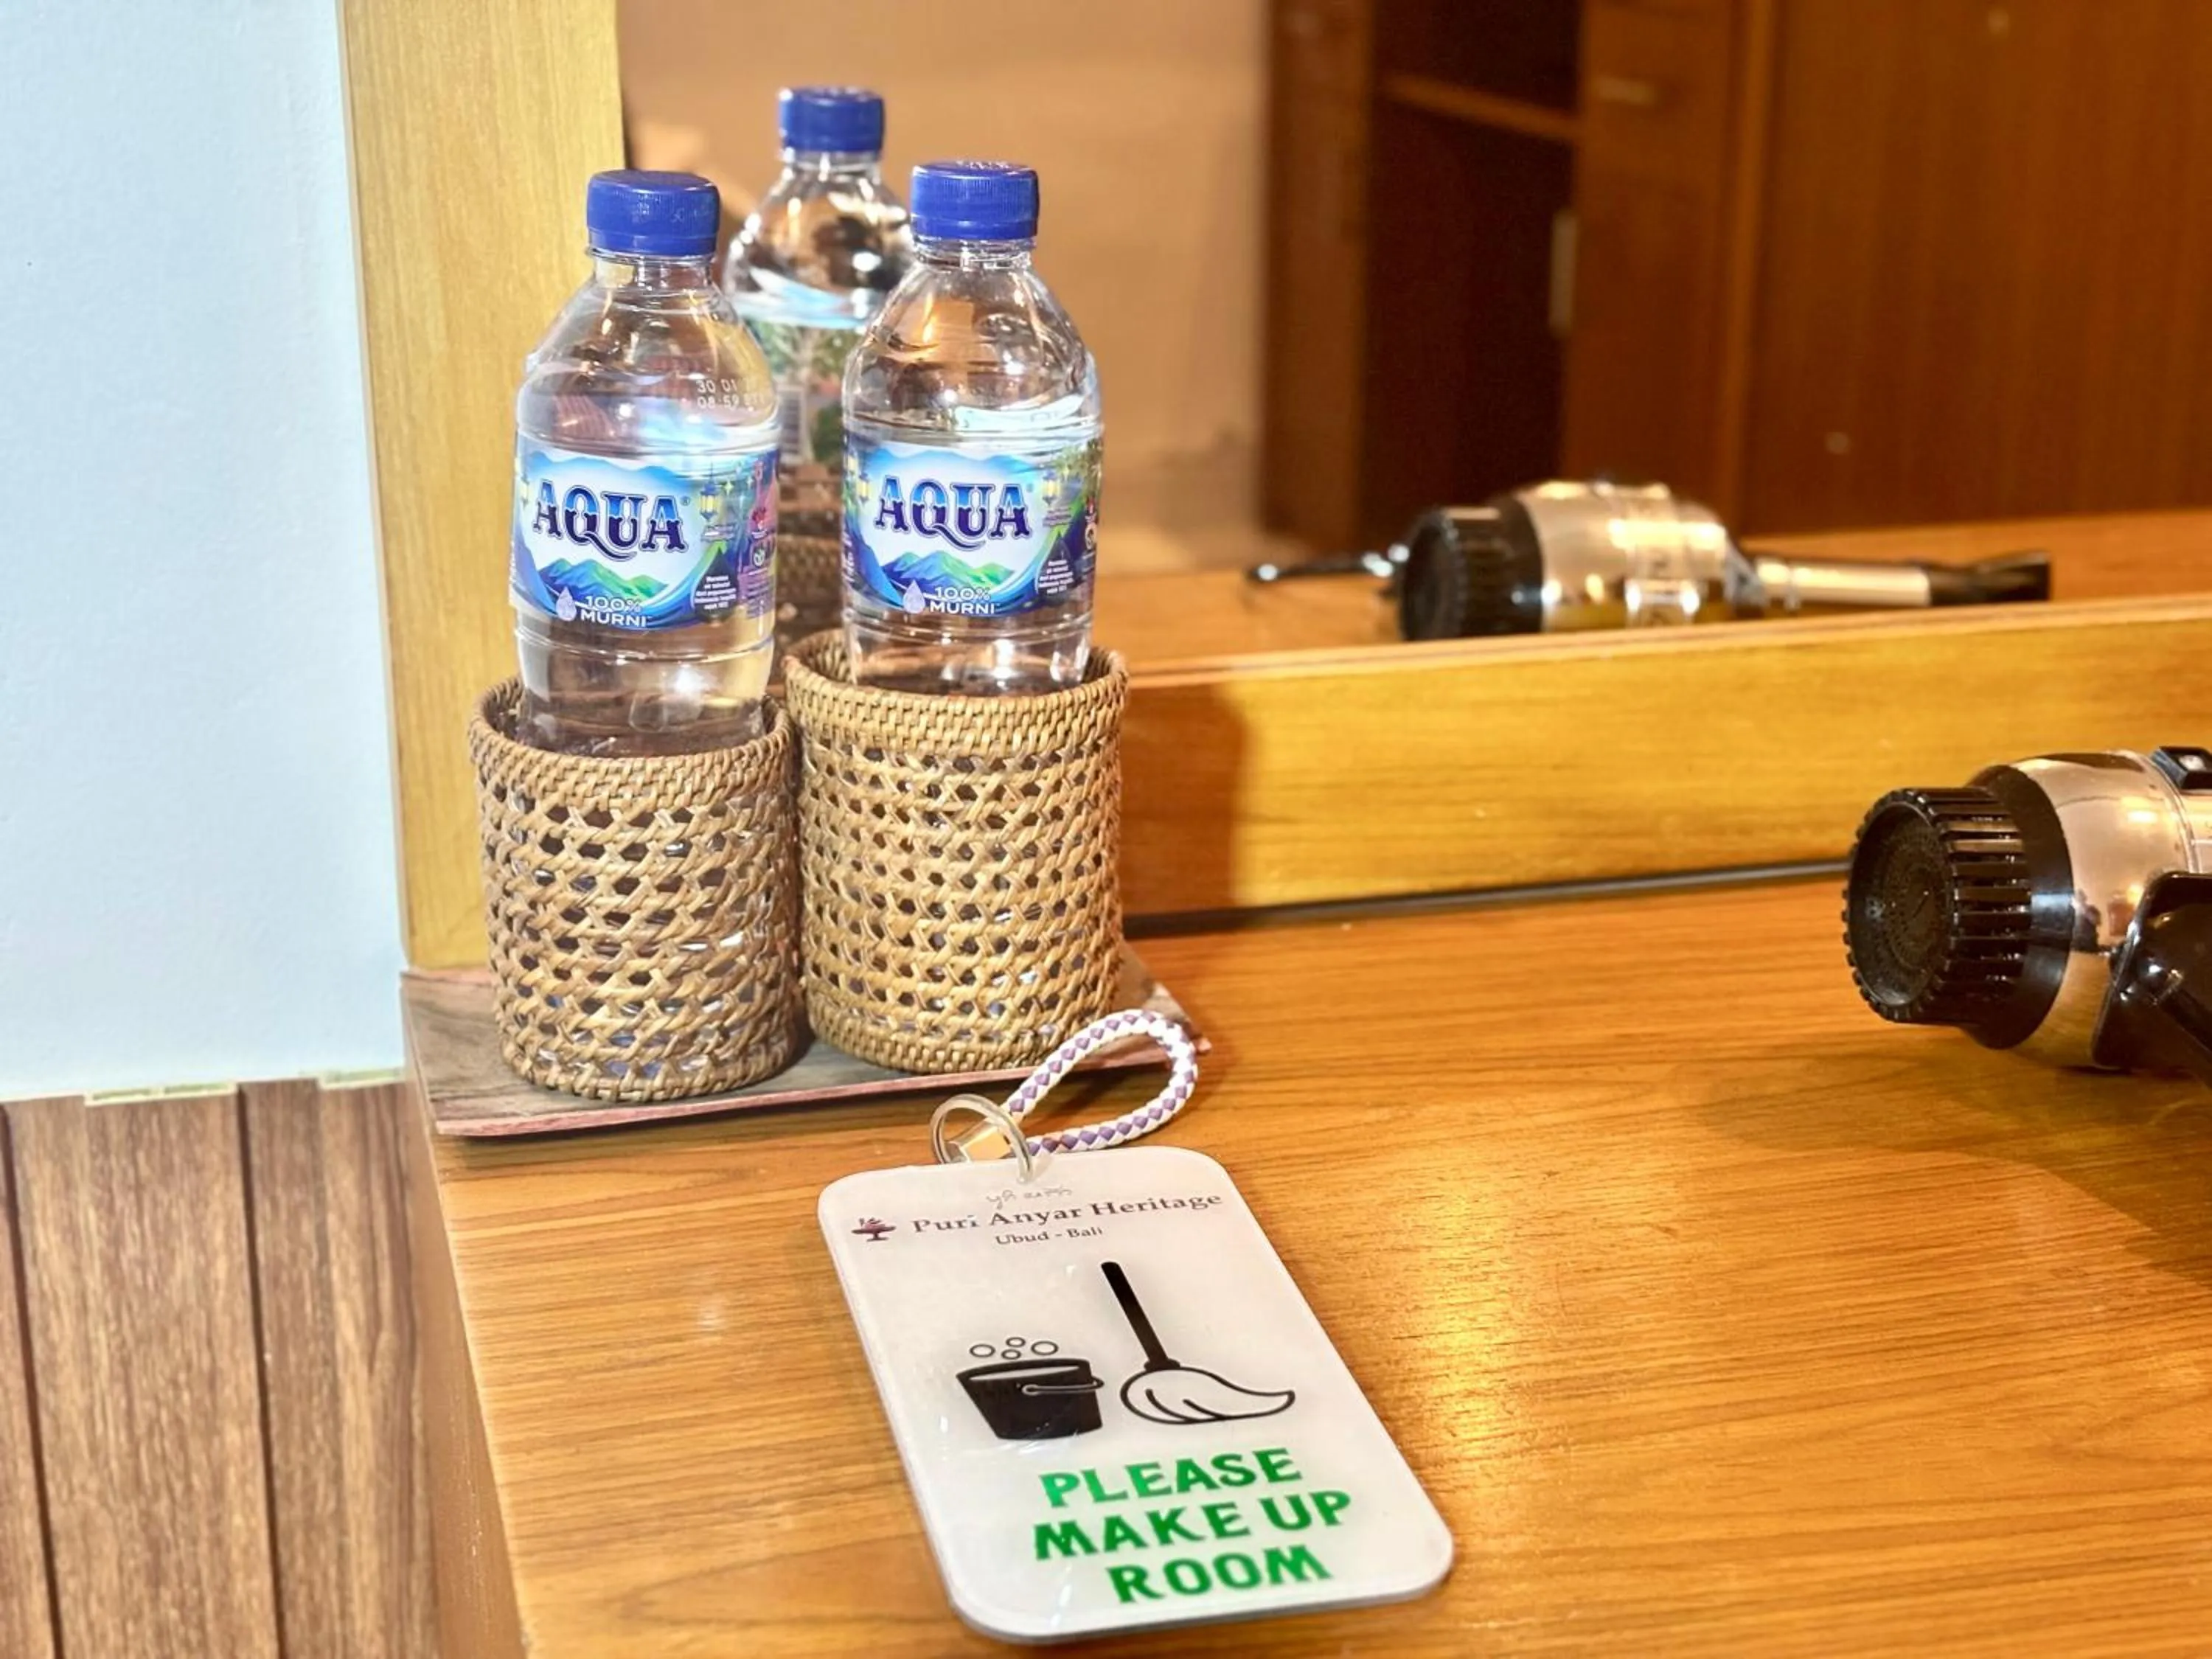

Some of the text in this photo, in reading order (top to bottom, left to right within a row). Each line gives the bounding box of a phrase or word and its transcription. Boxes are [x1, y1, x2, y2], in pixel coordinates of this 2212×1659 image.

[696, 380, 716, 394] 30
[532, 479, 687, 560] AQUA
[874, 475, 1030, 551] AQUA
[585, 594, 641, 613] 100%
[930, 599, 995, 614] MURNI
[934, 586, 990, 601] 100%
[580, 608, 647, 627] MURNI
[911, 1214, 979, 1234] Puri
[990, 1208, 1082, 1227] Anyar
[1089, 1192, 1223, 1217] Heritage
[995, 1231, 1051, 1245] Ubud
[1066, 1225, 1104, 1239] Bali
[1038, 1447, 1303, 1508] PLEASE
[1033, 1490, 1351, 1561] MAKE UP
[1105, 1544, 1332, 1604] ROOM
